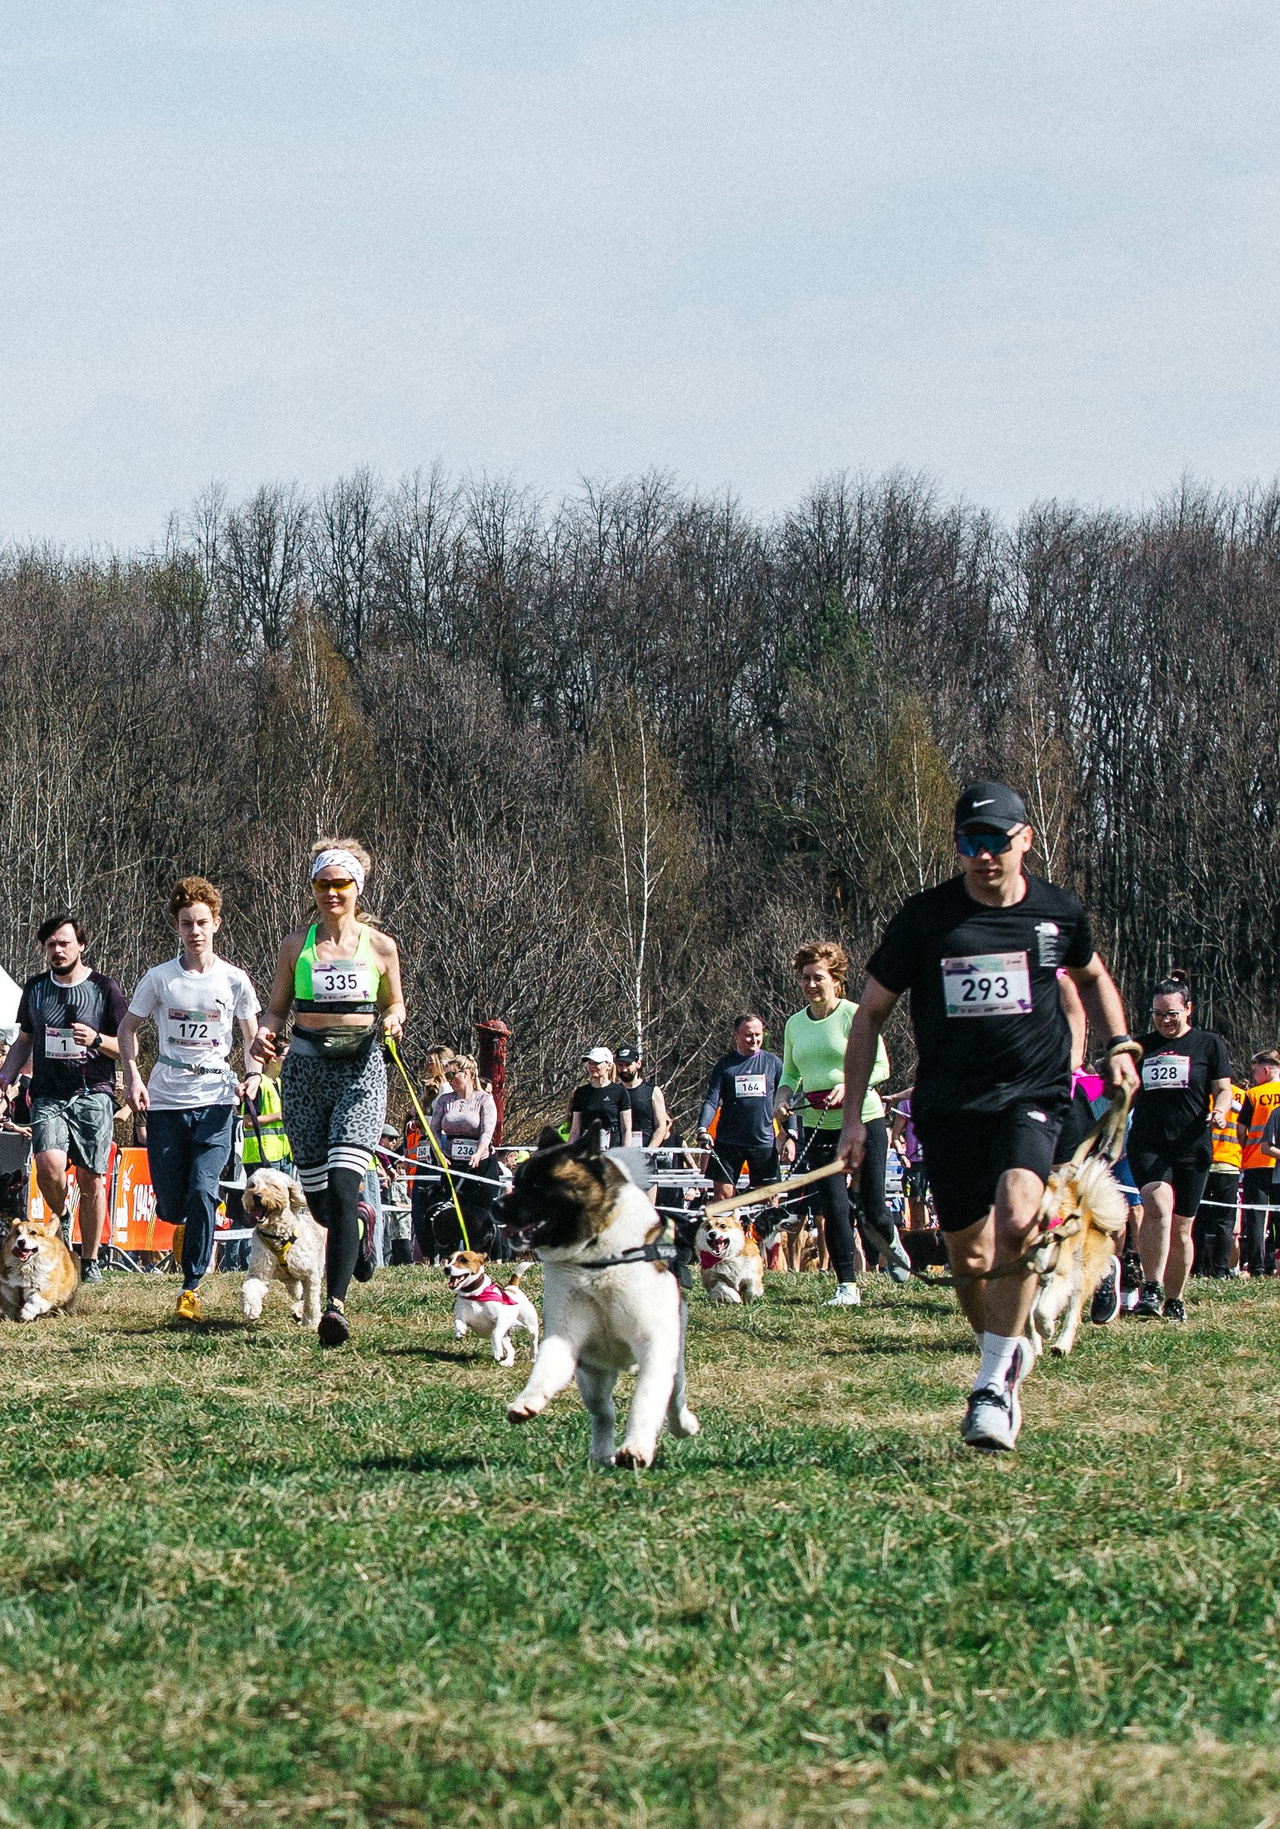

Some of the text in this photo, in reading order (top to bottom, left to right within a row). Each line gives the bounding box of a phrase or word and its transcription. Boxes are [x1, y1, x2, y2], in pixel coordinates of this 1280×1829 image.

[324, 974, 358, 991] 335
[961, 976, 1009, 1002] 293
[179, 1023, 208, 1038] 172
[61, 1039, 67, 1051] 1
[1150, 1066, 1178, 1081] 328
[742, 1083, 759, 1092] 164
[457, 1146, 474, 1156] 236
